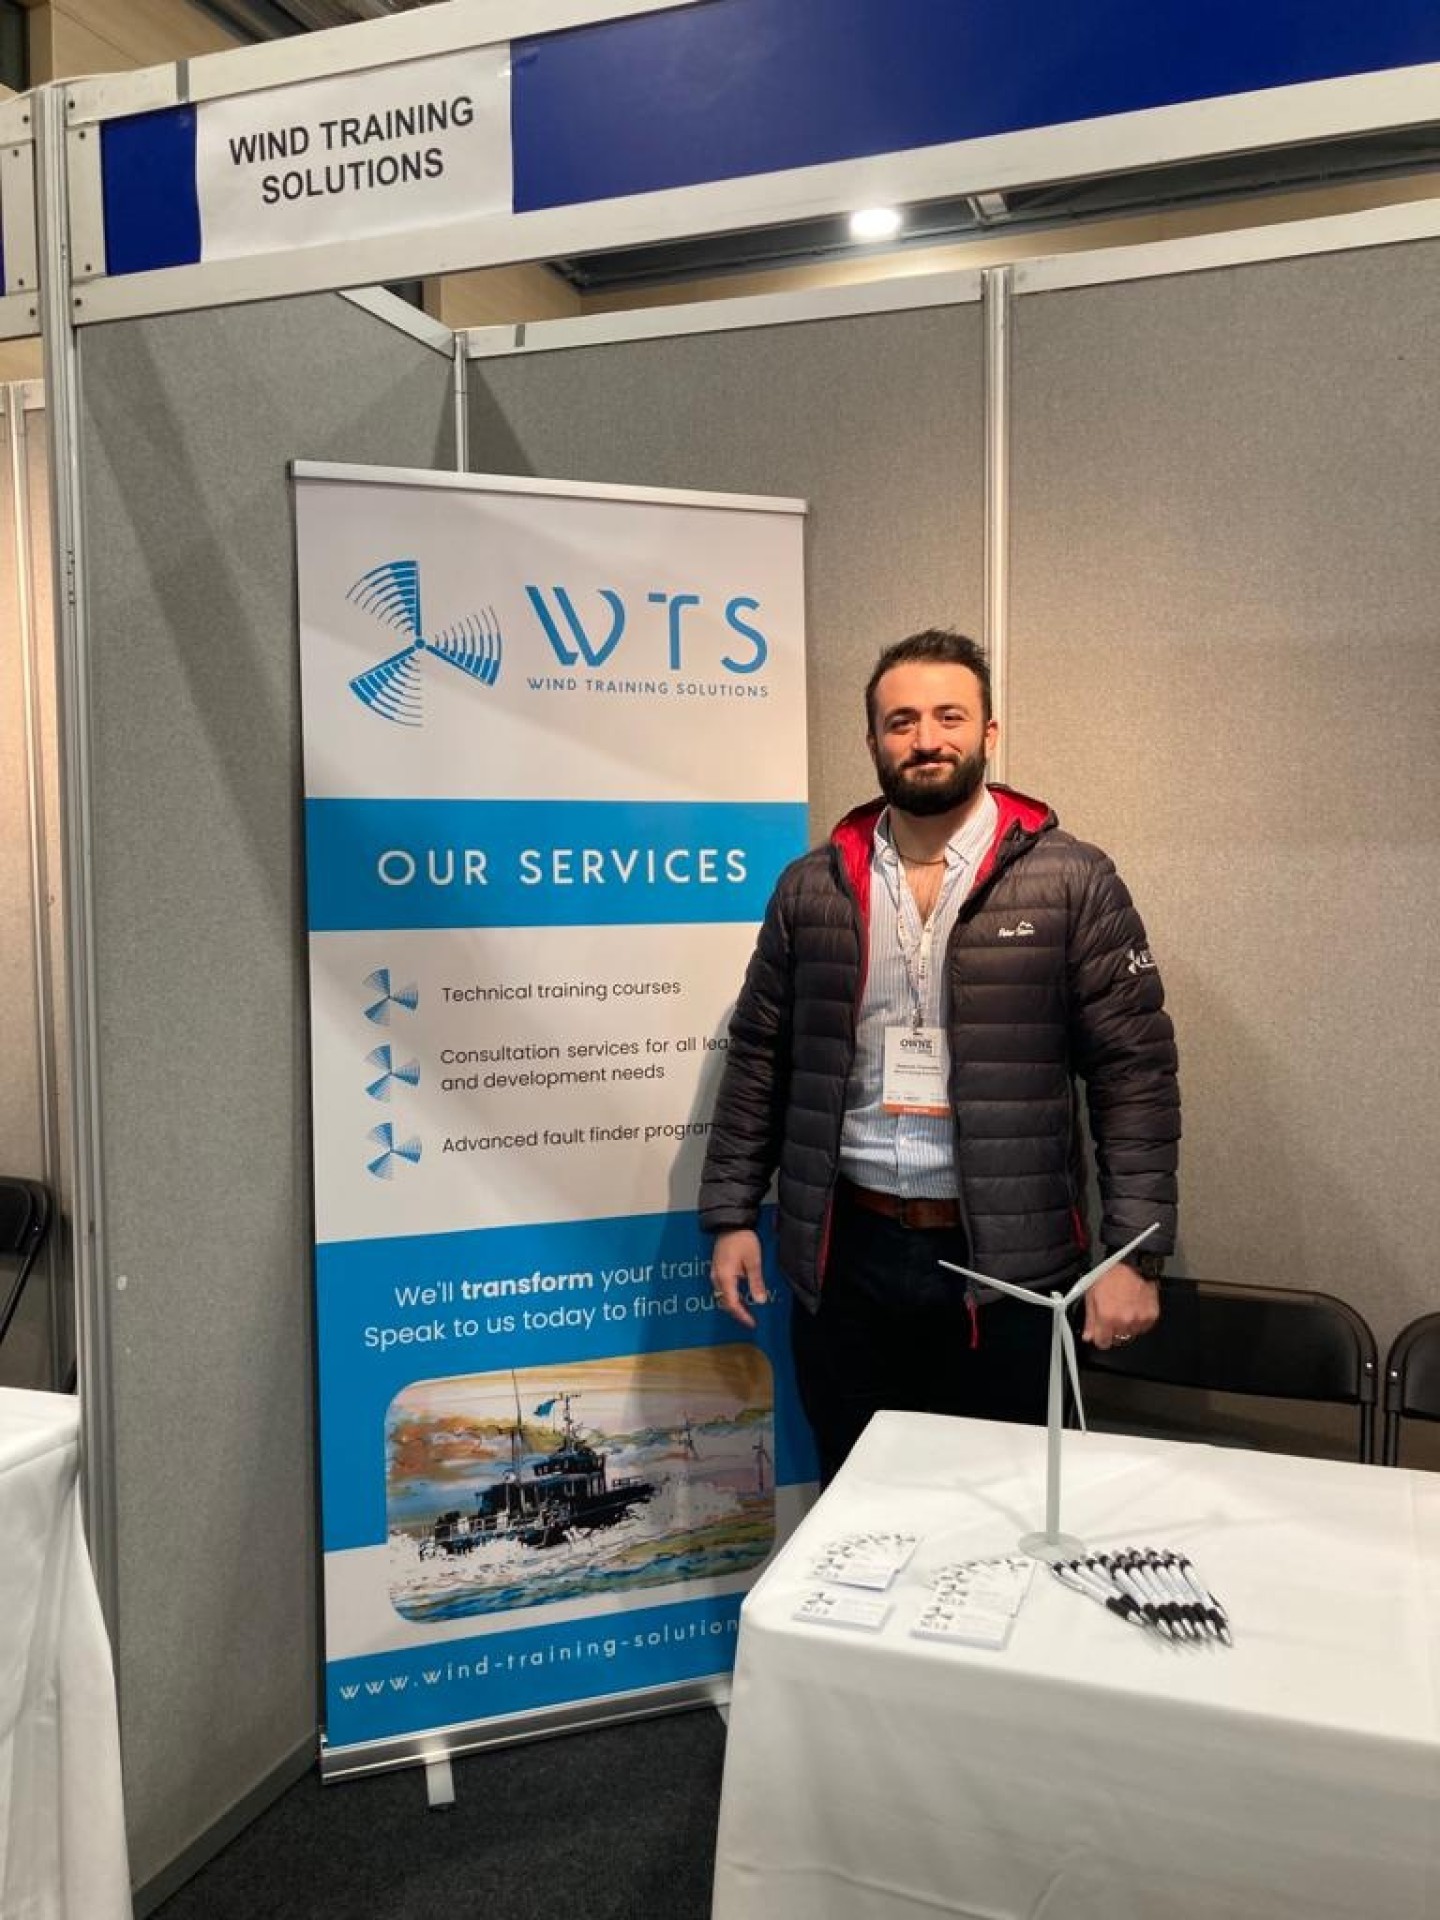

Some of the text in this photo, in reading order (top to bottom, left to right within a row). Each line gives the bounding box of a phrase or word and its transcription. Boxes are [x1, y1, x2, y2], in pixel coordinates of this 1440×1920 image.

[229, 96, 474, 166] WIND TRAINING
[262, 147, 444, 204] SOLUTIONS
[525, 585, 769, 674] WTS
[527, 677, 769, 698] WIND TRAINING SOLUTIONS
[377, 849, 748, 886] OUR SERVICES
[442, 980, 682, 1003] Technical training courses
[440, 1036, 729, 1065] Consultation services for all lea
[441, 1064, 665, 1091] and development needs
[442, 1131, 539, 1153] Advanced
[543, 1127, 585, 1145] fault
[589, 1124, 641, 1142] finder
[395, 1280, 454, 1307] We'll
[461, 1270, 593, 1300] transform
[602, 1264, 654, 1292] your
[365, 1319, 446, 1352] Speak
[453, 1318, 479, 1337] to
[486, 1314, 515, 1334] us
[523, 1306, 596, 1329] today
[603, 1301, 627, 1321] to
[633, 1293, 678, 1318] find
